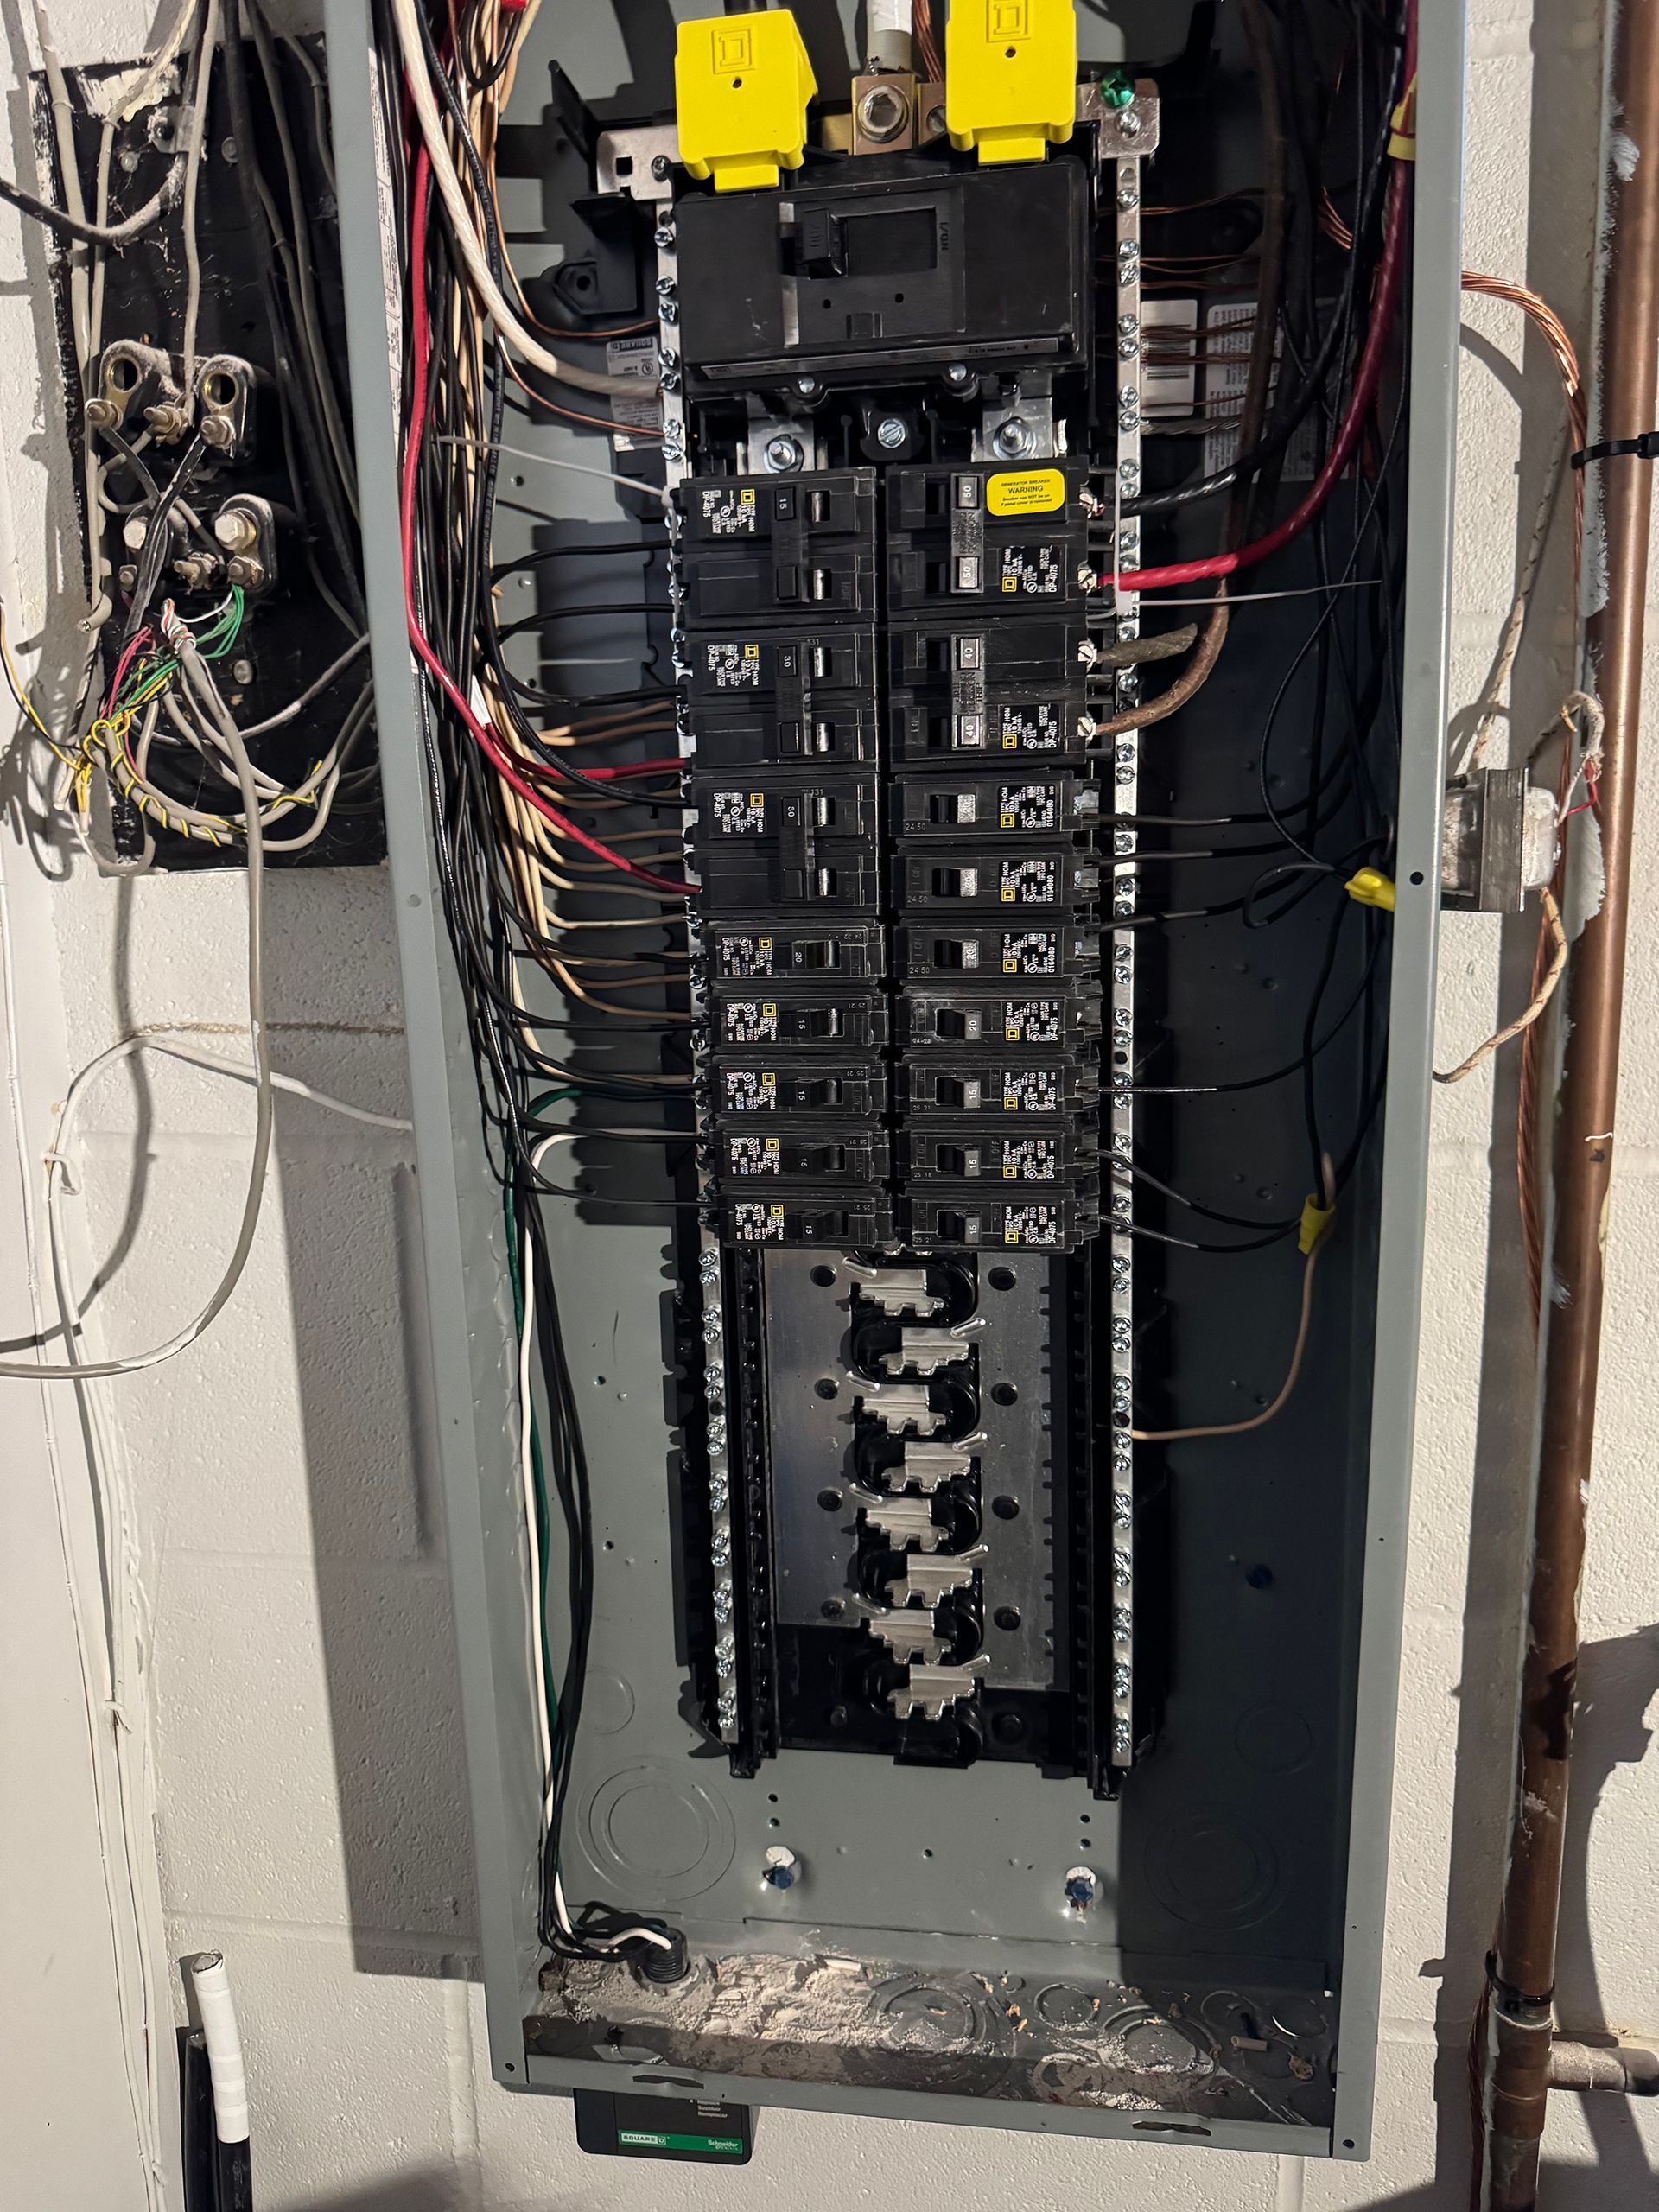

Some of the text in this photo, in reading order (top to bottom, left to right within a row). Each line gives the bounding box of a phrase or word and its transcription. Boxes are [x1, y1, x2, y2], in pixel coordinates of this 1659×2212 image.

[963, 486, 972, 498] 50
[1008, 485, 1043, 494] WARNING
[741, 505, 746, 513] 10
[779, 498, 787, 509] 15
[963, 566, 971, 578] 50
[1011, 567, 1017, 576] 10
[1049, 565, 1057, 592] DP-4075
[965, 648, 973, 659] 40
[783, 655, 791, 667] 30
[966, 725, 974, 737] 40
[1048, 722, 1056, 748] DP-4075
[787, 806, 795, 817] 30
[795, 952, 802, 963] 20
[966, 949, 975, 960] 20
[798, 1020, 806, 1030] 15
[969, 1020, 977, 1031] 20
[798, 1091, 806, 1101] 15
[969, 1090, 977, 1099] 15
[800, 1158, 808, 1168] 15
[969, 1158, 977, 1169] 15
[805, 1225, 813, 1235] 15
[969, 1224, 977, 1235] 15
